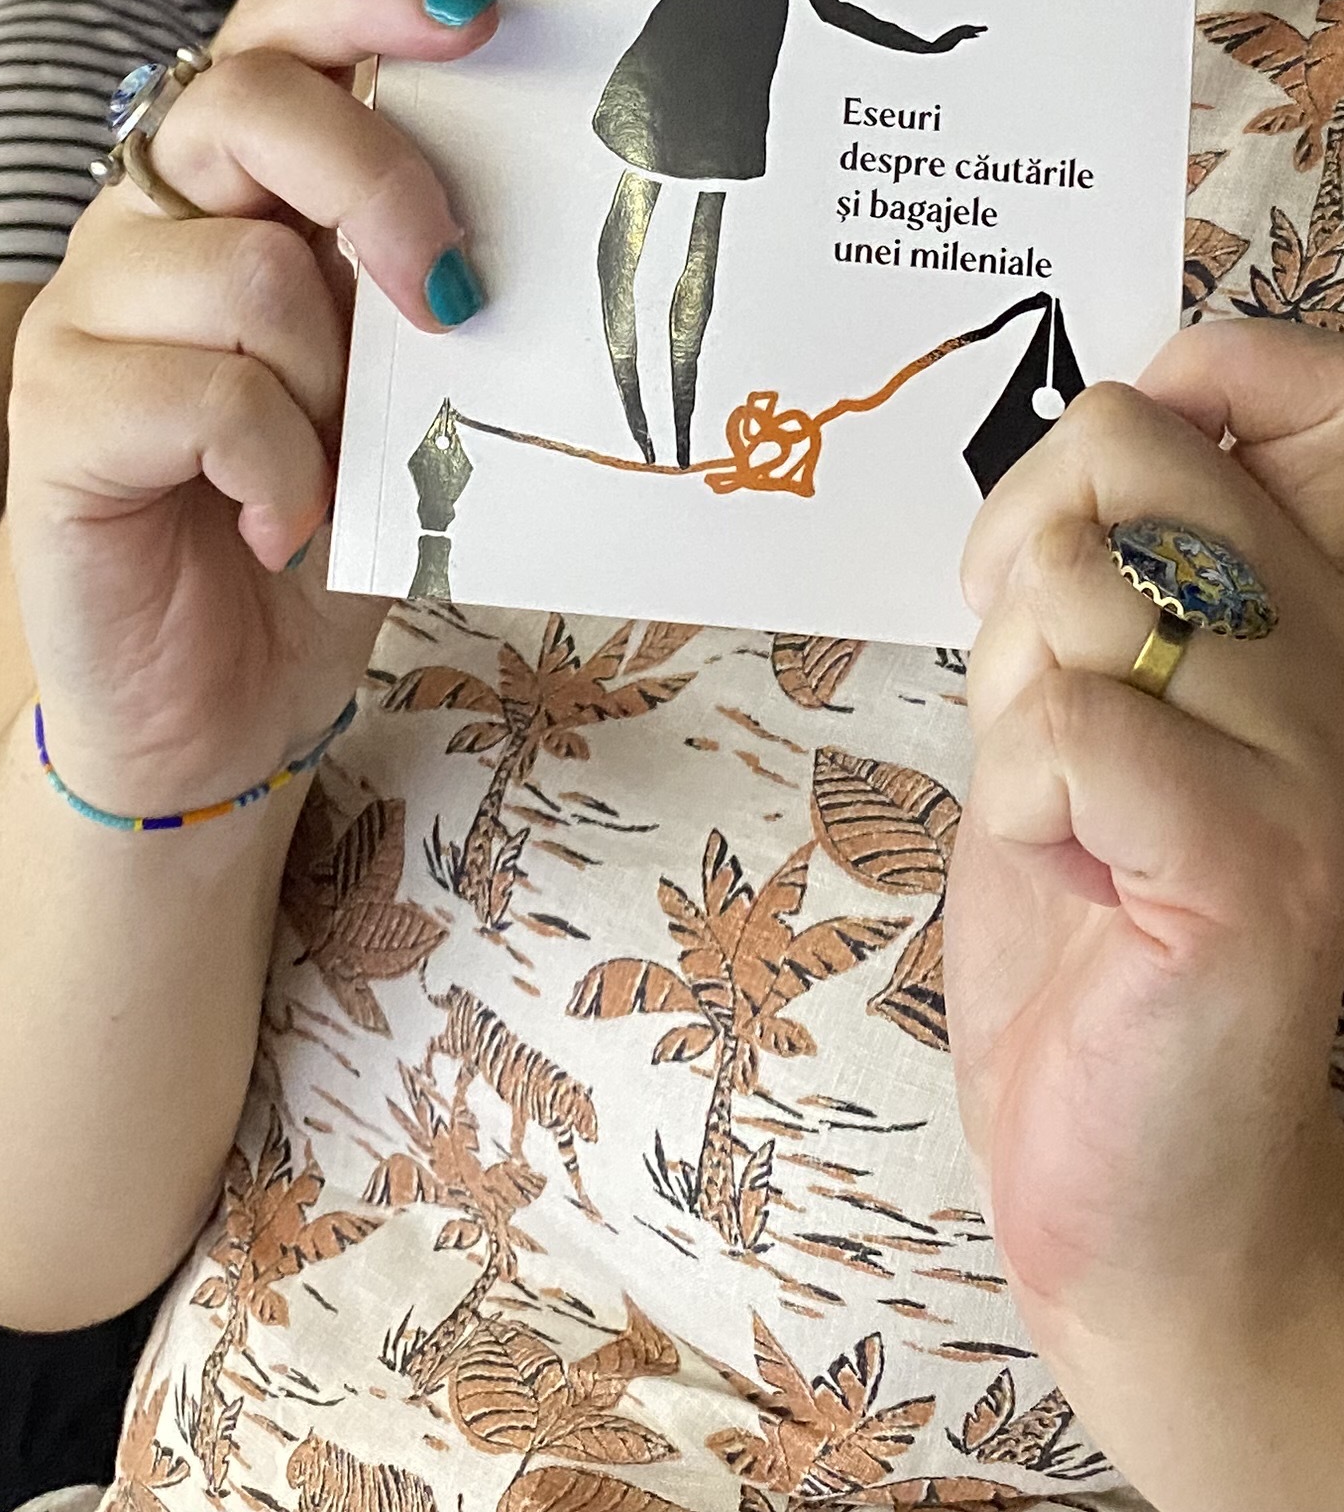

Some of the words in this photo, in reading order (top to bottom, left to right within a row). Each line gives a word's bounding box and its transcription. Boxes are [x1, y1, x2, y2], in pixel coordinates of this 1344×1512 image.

[843, 97, 941, 132] Eseuri
[839, 141, 946, 184] despre
[955, 154, 1094, 189] căutările
[836, 189, 861, 223] și
[869, 188, 998, 234] bagajele
[834, 238, 901, 266] unei
[910, 240, 1053, 279] mileniale
